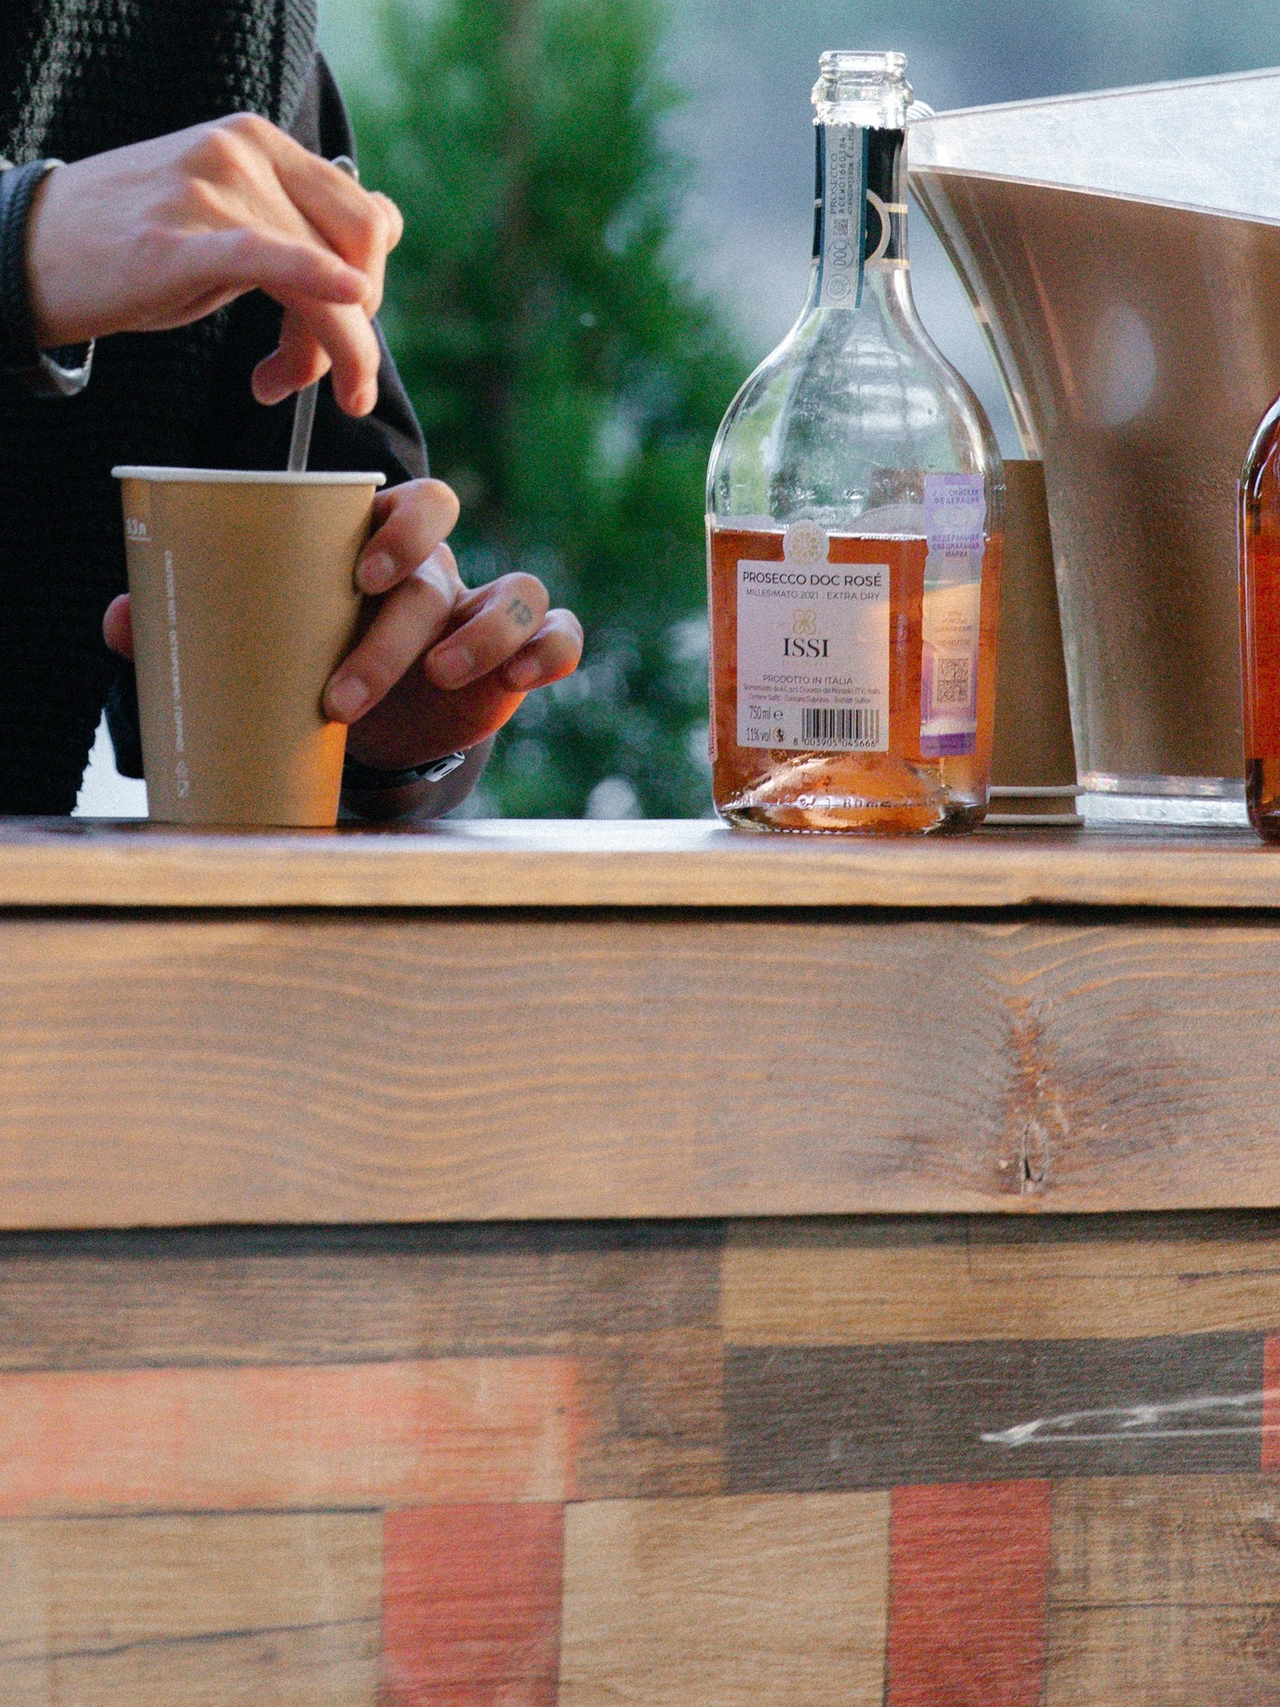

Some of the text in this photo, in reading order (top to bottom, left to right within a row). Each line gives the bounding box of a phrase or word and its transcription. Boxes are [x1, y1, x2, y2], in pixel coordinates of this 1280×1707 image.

[830, 152, 839, 215] PROSECCO
[833, 243, 848, 267] DOC
[742, 571, 882, 587] PROSECCO DOC ROSÉ
[746, 588, 881, 601] MILLESIMATO 2021 EXTRA DRY
[783, 637, 830, 658] ISSI
[763, 674, 853, 685] PRODOTTO IN ITALIA
[793, 737, 799, 745] 8
[841, 739, 877, 748] 045666
